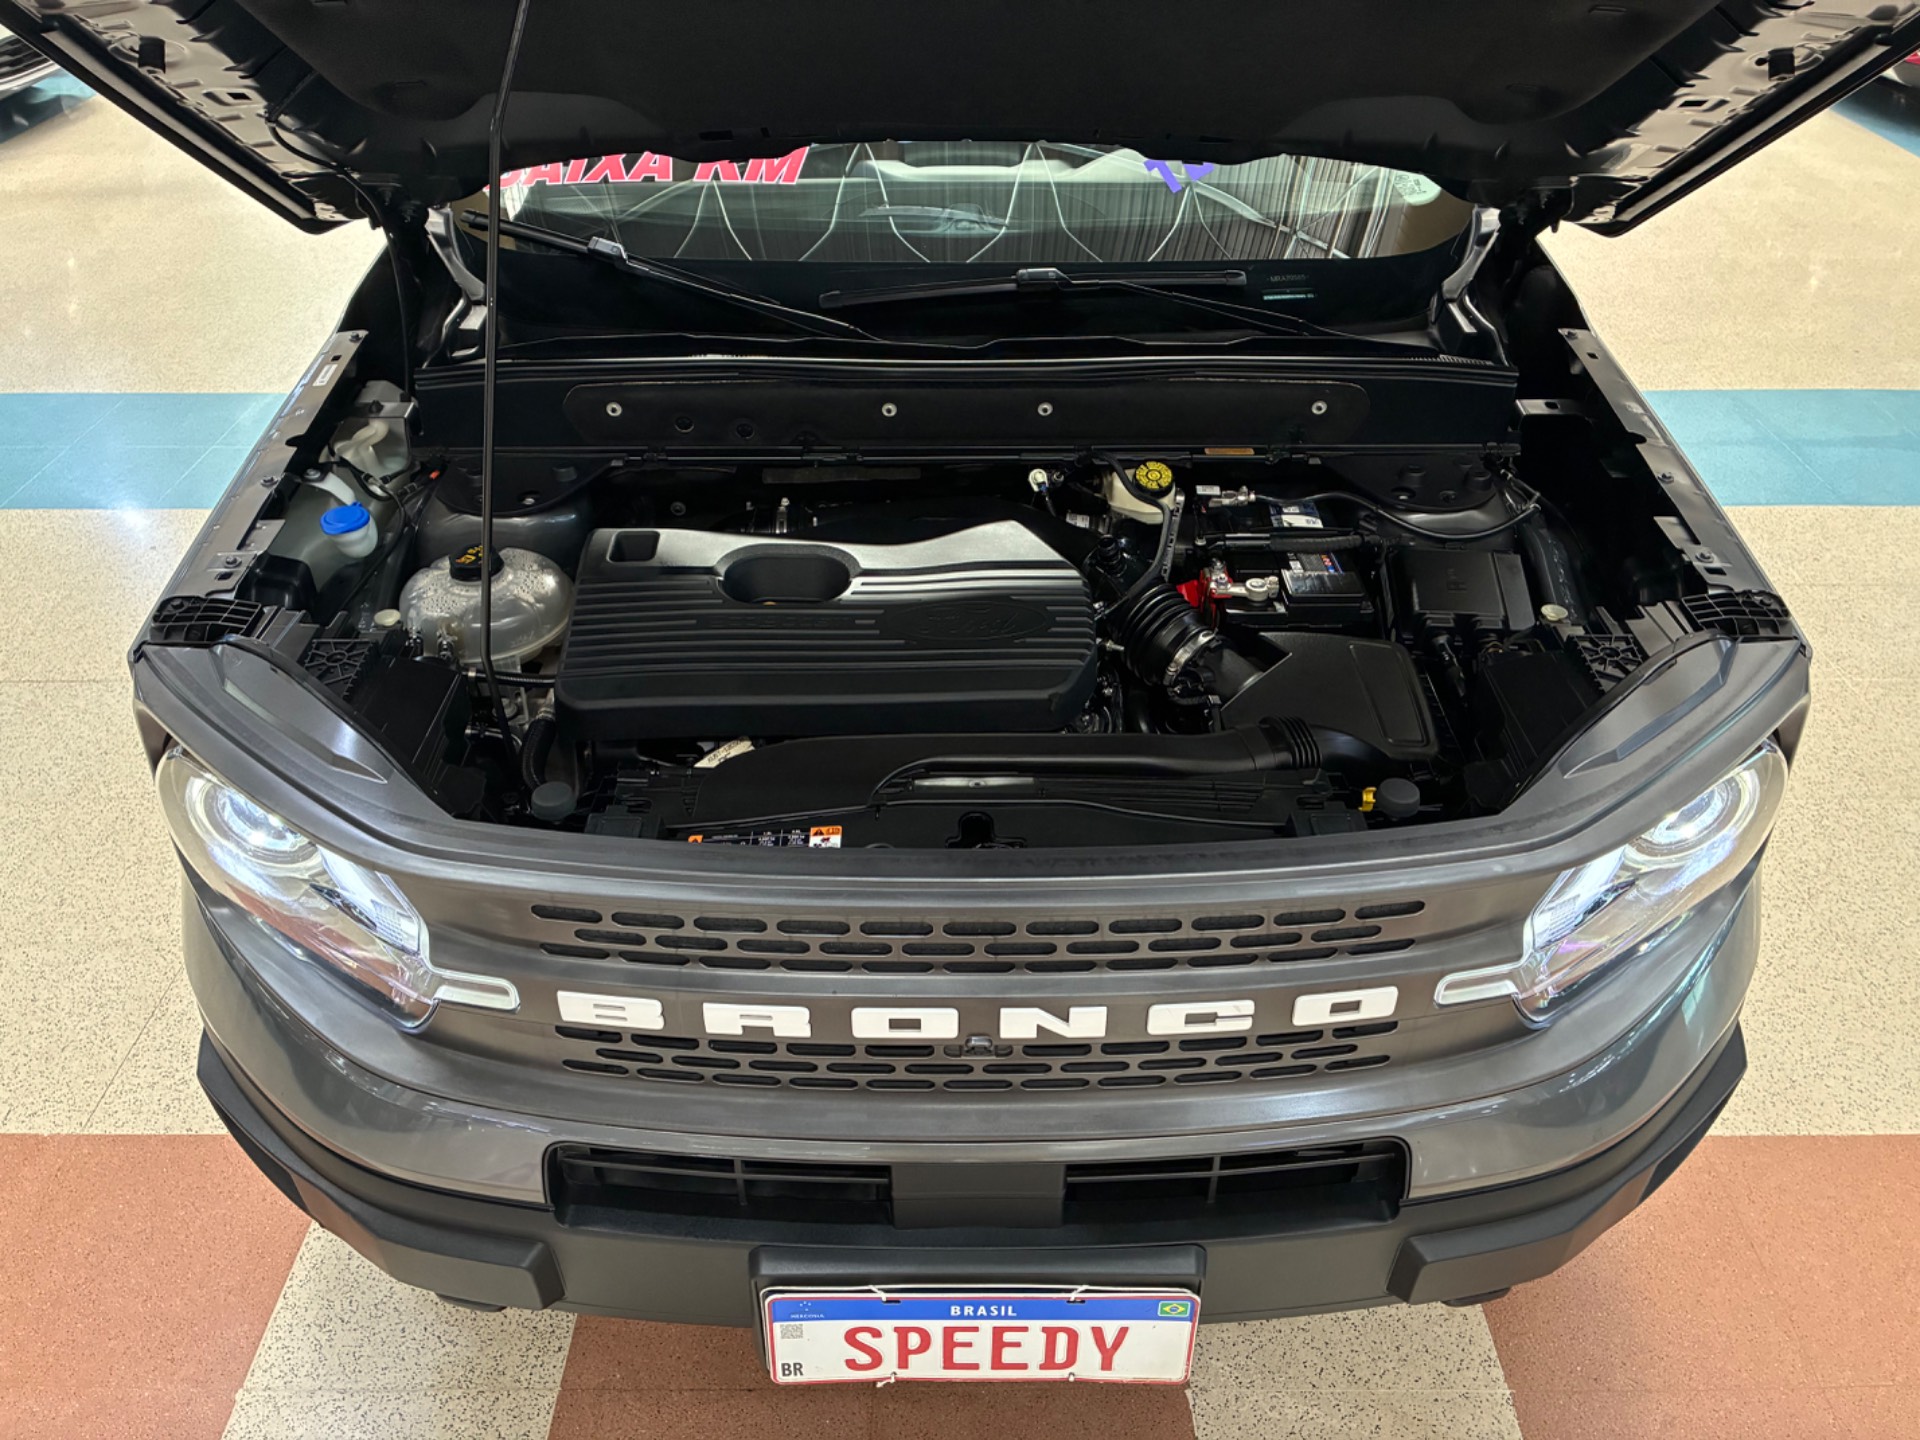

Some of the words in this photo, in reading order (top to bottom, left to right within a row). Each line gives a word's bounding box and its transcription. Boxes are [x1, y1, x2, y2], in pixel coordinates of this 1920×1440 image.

[556, 985, 1399, 1039] BRONCO
[951, 1305, 1017, 1316] BRASIL
[843, 1326, 1129, 1372] SPEEDY
[781, 1362, 804, 1377] BR
